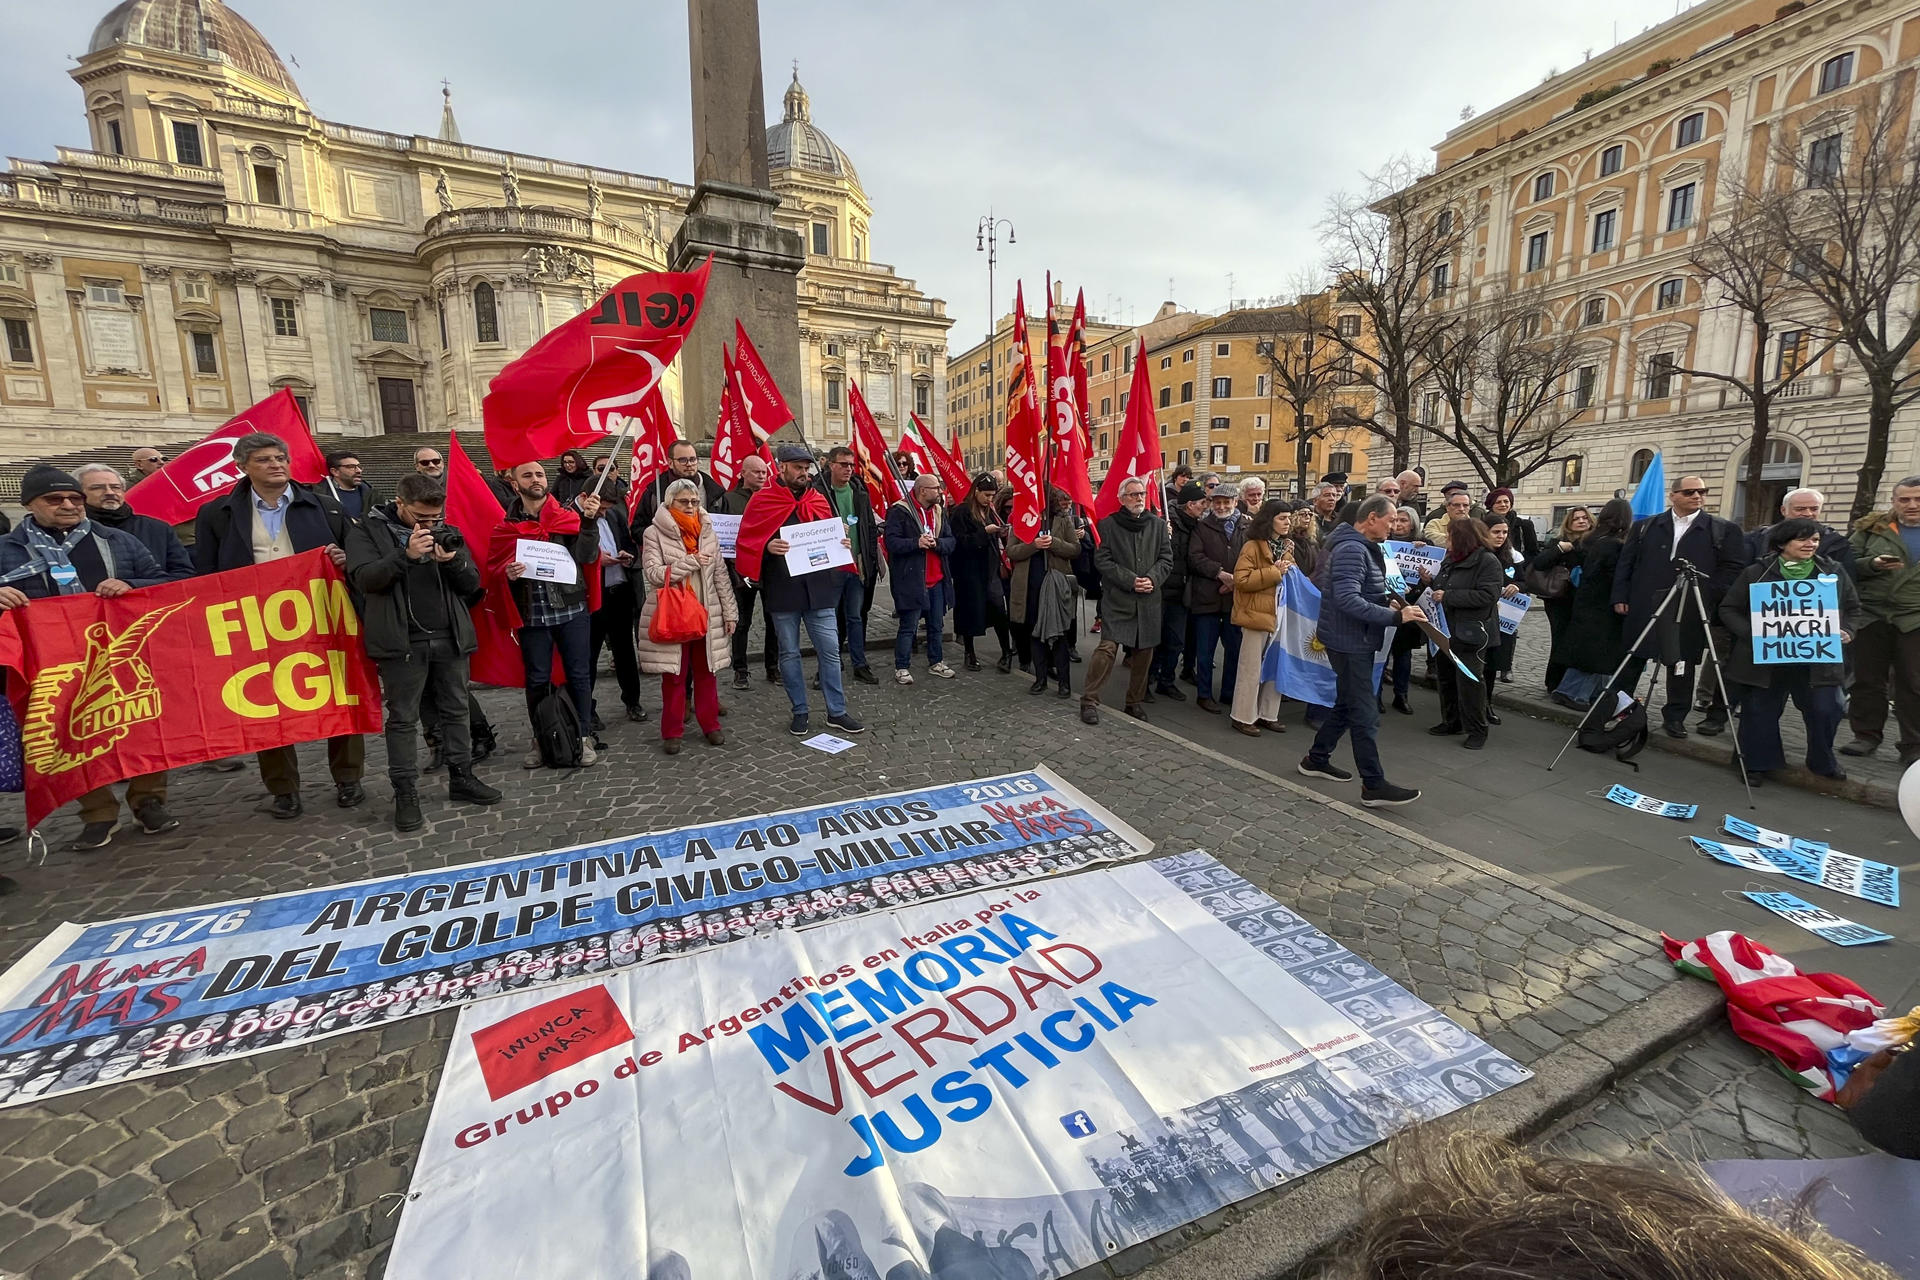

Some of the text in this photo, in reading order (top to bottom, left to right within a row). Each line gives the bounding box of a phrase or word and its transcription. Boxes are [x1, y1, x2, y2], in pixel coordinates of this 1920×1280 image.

[1410, 548, 1430, 557] final
[206, 578, 358, 656] FIOM
[1771, 581, 1815, 599] NO
[1763, 641, 1836, 660] MUSK
[81, 697, 152, 736] FIOM
[962, 779, 1039, 802] 2016
[981, 796, 1068, 823] NUNCA
[1014, 811, 1094, 841] MAS
[303, 800, 938, 937] ARGENTINA A 40 AÑOS
[103, 910, 252, 954] 1976
[200, 820, 1005, 1001] DEL GOLPE CIVICO-MILITAR
[1782, 909, 1841, 924] PARO
[36, 946, 207, 1007] NUNCA
[142, 852, 1041, 1056] 30.000 compañeros desaparecidos PRESENTES
[6, 977, 196, 1046] MAS
[454, 1079, 600, 1149] Grupo
[613, 1051, 663, 1079] de
[863, 948, 900, 970] en
[901, 918, 973, 950] Italia
[973, 899, 1014, 924] por
[1013, 888, 1042, 905] la
[747, 913, 1058, 1076] MEMORIA
[774, 943, 1103, 1117] VERDAD
[843, 981, 1158, 1178] JUSTICIA
